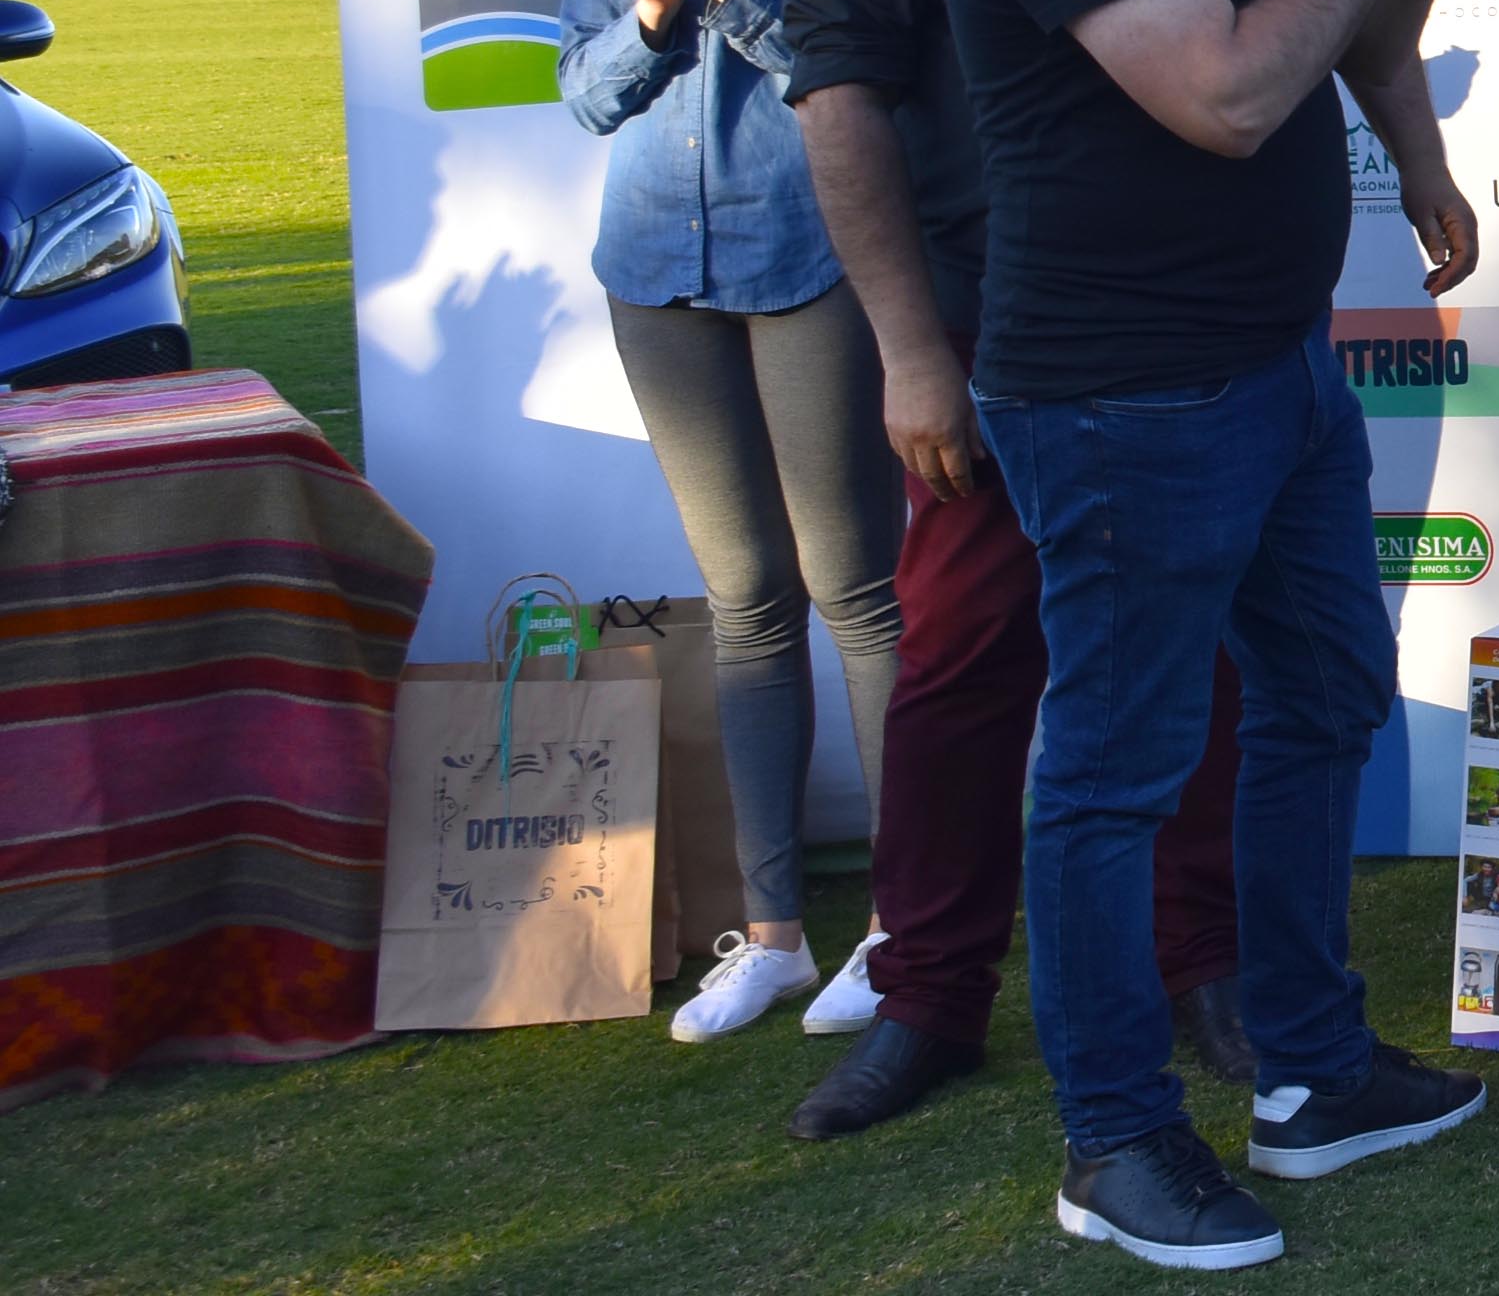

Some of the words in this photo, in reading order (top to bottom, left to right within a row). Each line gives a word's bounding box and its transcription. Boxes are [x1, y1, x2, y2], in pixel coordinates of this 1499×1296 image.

[1352, 181, 1400, 192] AGONIA
[1335, 338, 1469, 387] ITRISIO
[467, 814, 584, 852] DITRISIO
